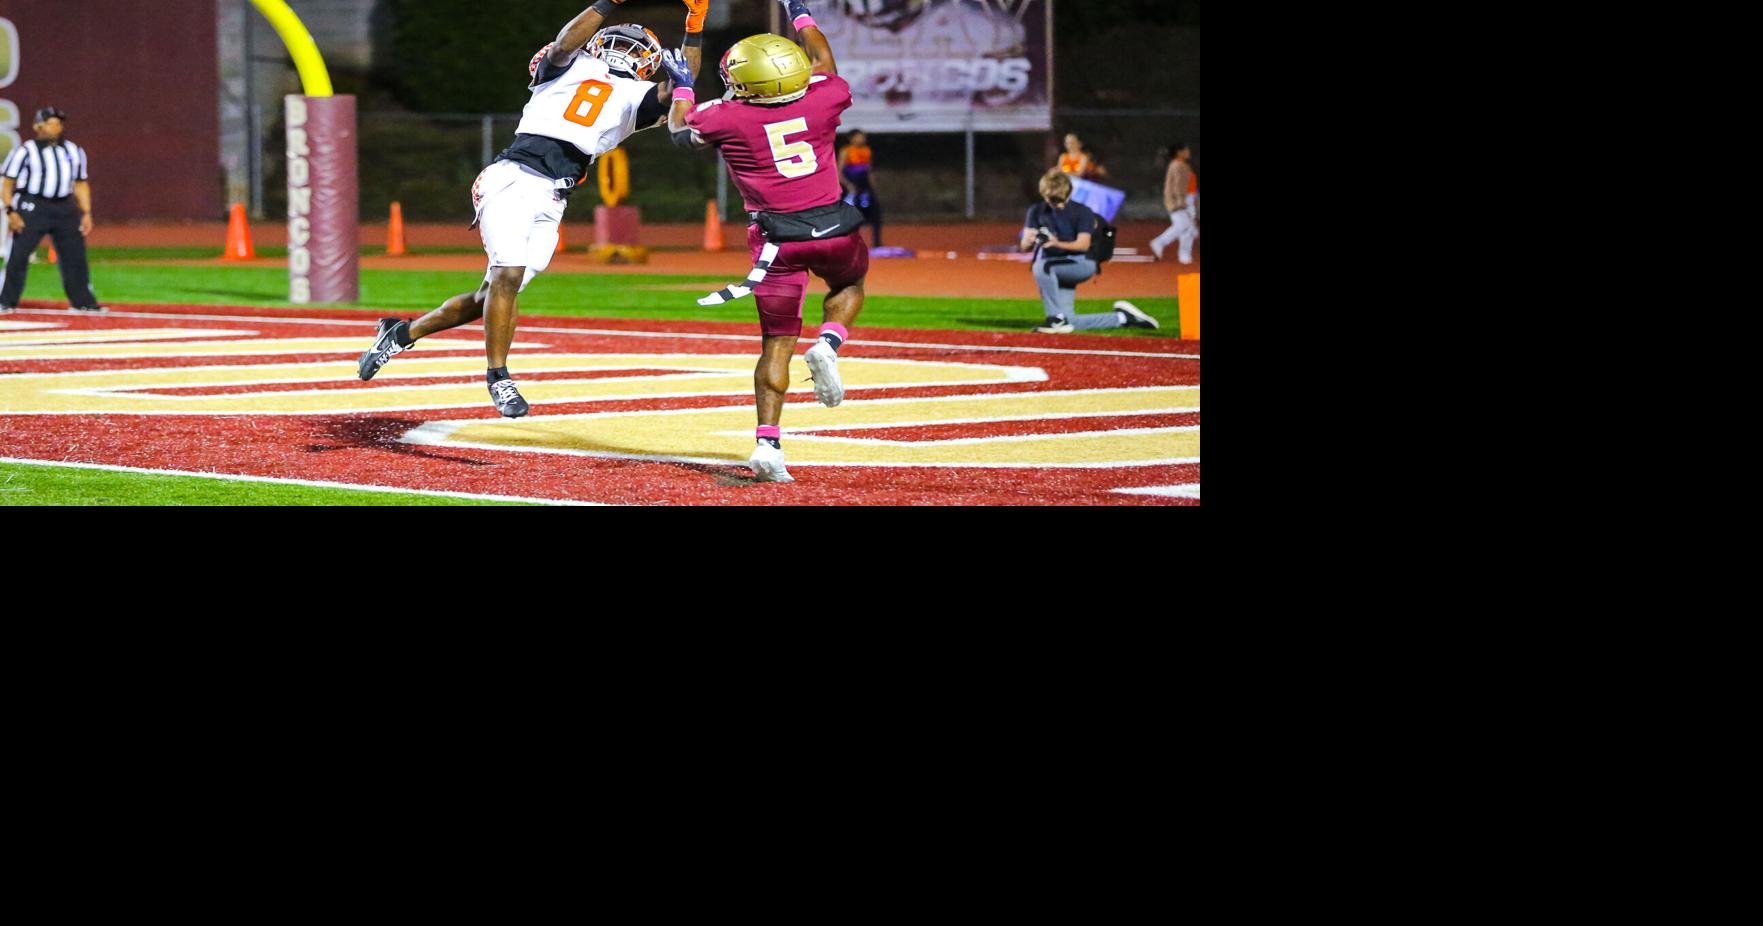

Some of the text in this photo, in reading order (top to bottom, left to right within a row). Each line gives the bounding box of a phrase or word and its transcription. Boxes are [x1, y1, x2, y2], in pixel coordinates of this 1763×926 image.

[838, 57, 1032, 92] RONCOS
[563, 79, 613, 127] 8
[763, 117, 818, 178] 5
[286, 96, 311, 304] BRONCOS
